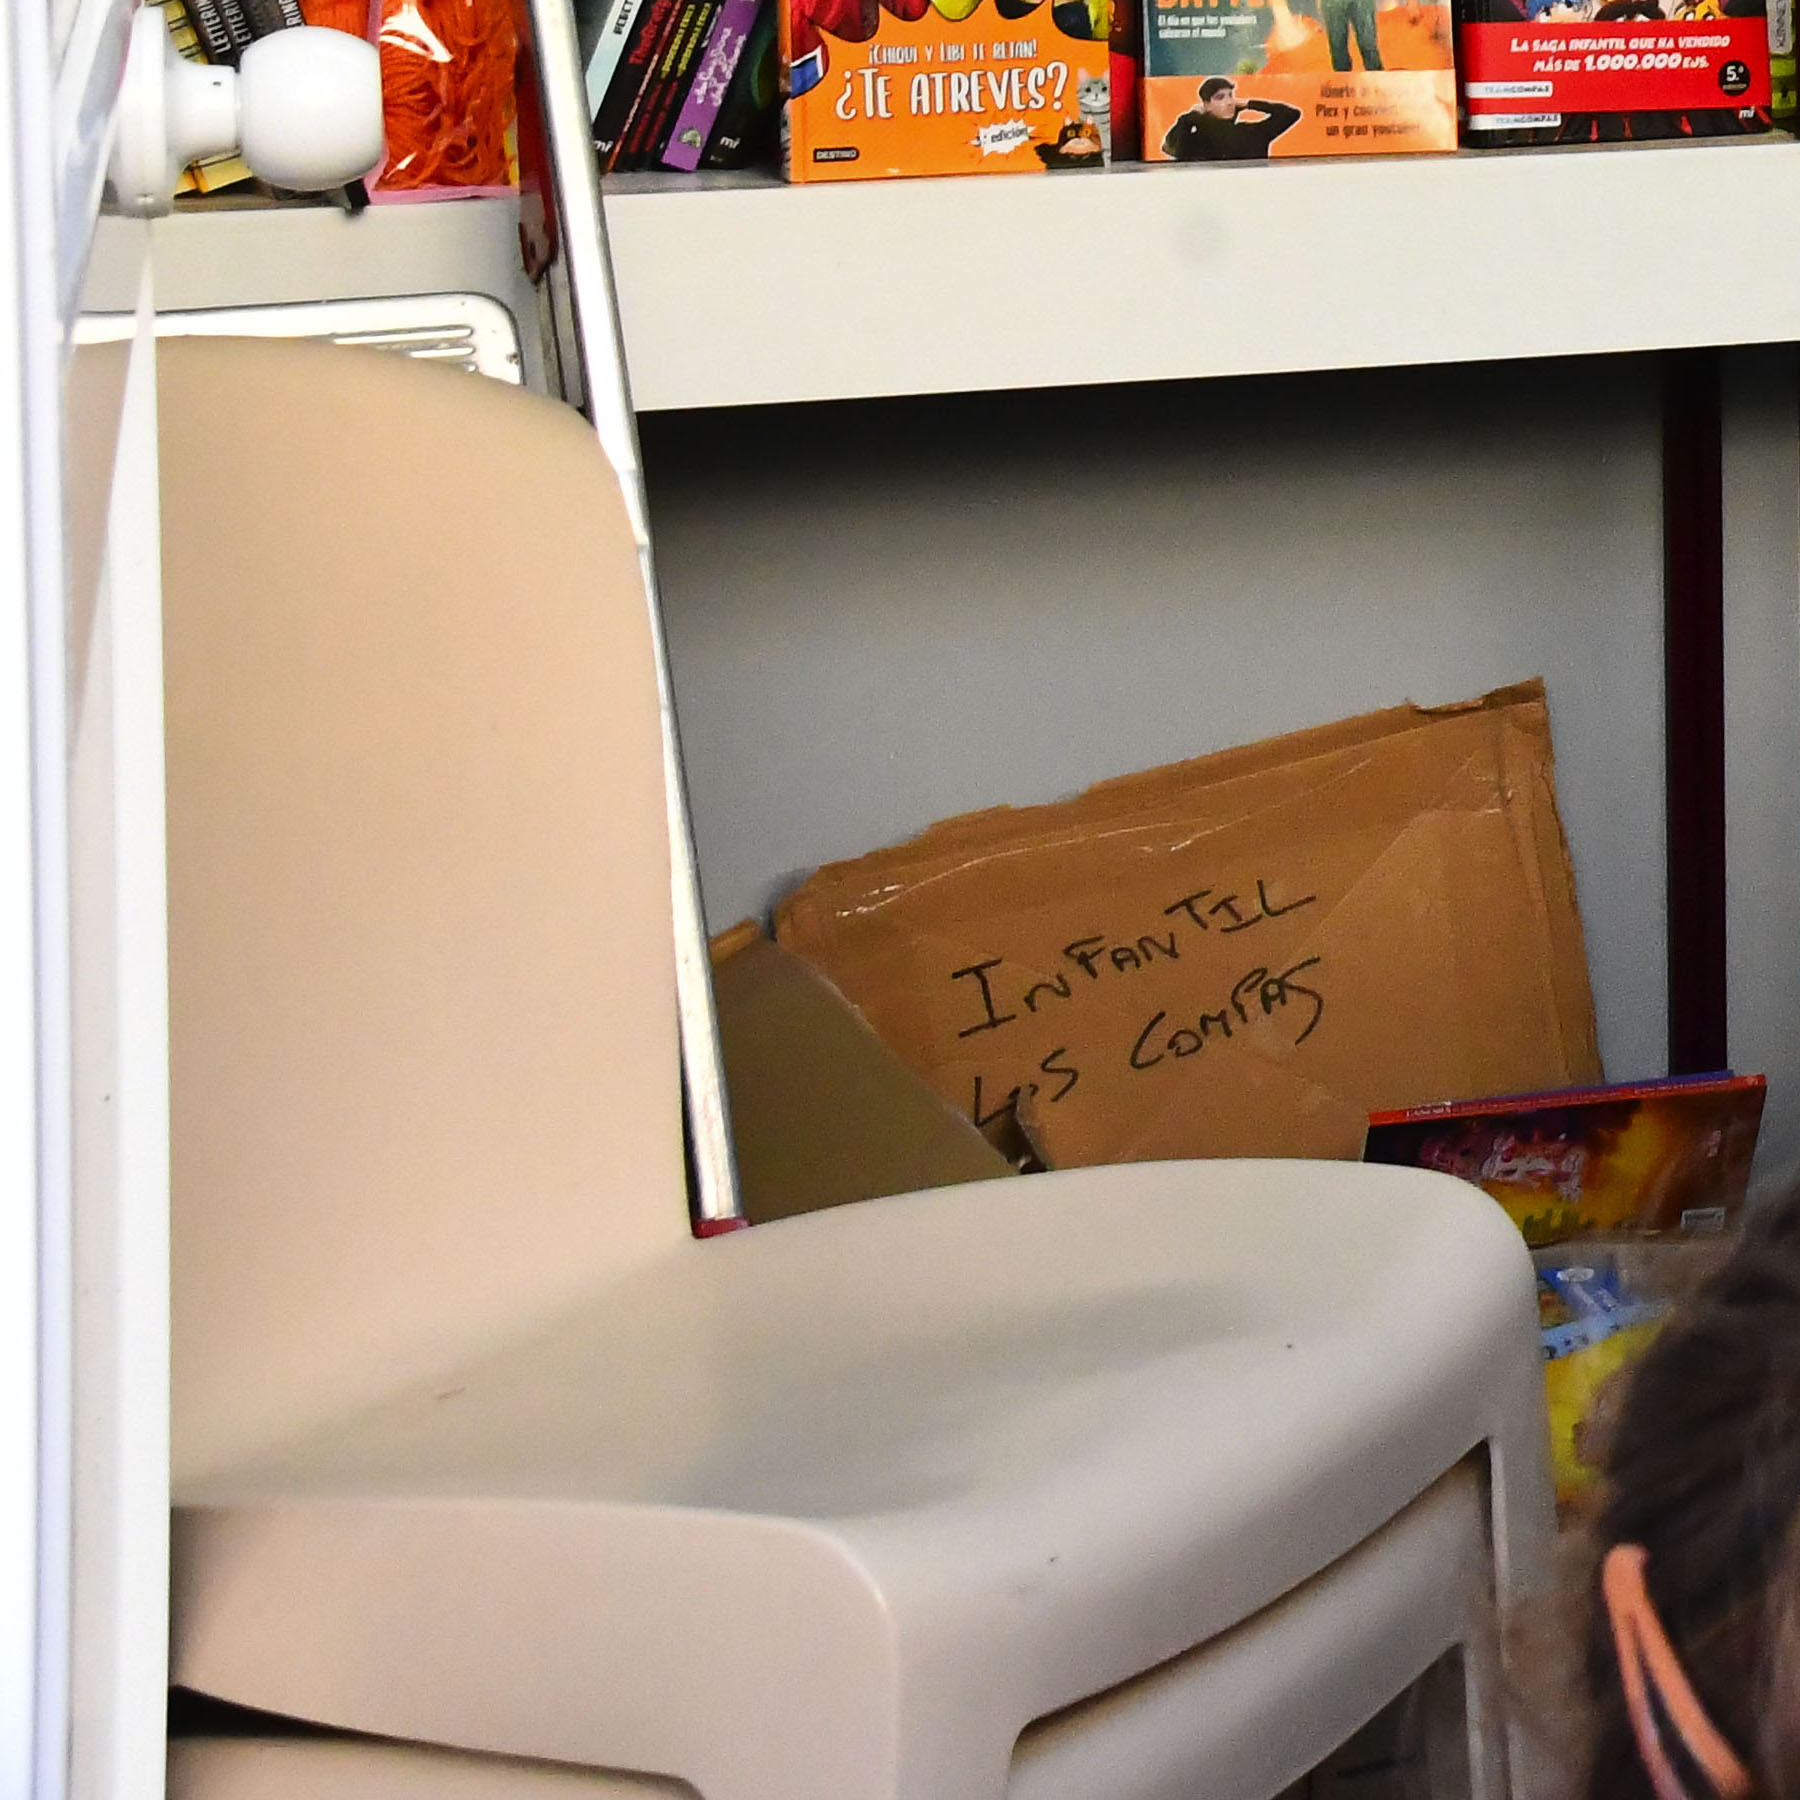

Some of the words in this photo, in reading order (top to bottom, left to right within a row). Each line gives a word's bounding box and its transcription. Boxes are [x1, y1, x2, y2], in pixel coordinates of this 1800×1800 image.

[1510, 38, 1528, 53] LA
[1532, 38, 1566, 52] SAGA
[1569, 38, 1625, 51] INFANTIL
[1628, 37, 1652, 50] QUE
[1656, 36, 1676, 49] HA
[1677, 34, 1731, 49] VENDIDO
[1534, 56, 1558, 72] MÁS
[1584, 53, 1680, 72] 1.000.000
[836, 69, 892, 119] ¿TE
[911, 62, 1067, 115] ATREVES?
[951, 878, 1318, 1040] INFANTIL
[1129, 957, 1324, 1071] COMPAS
